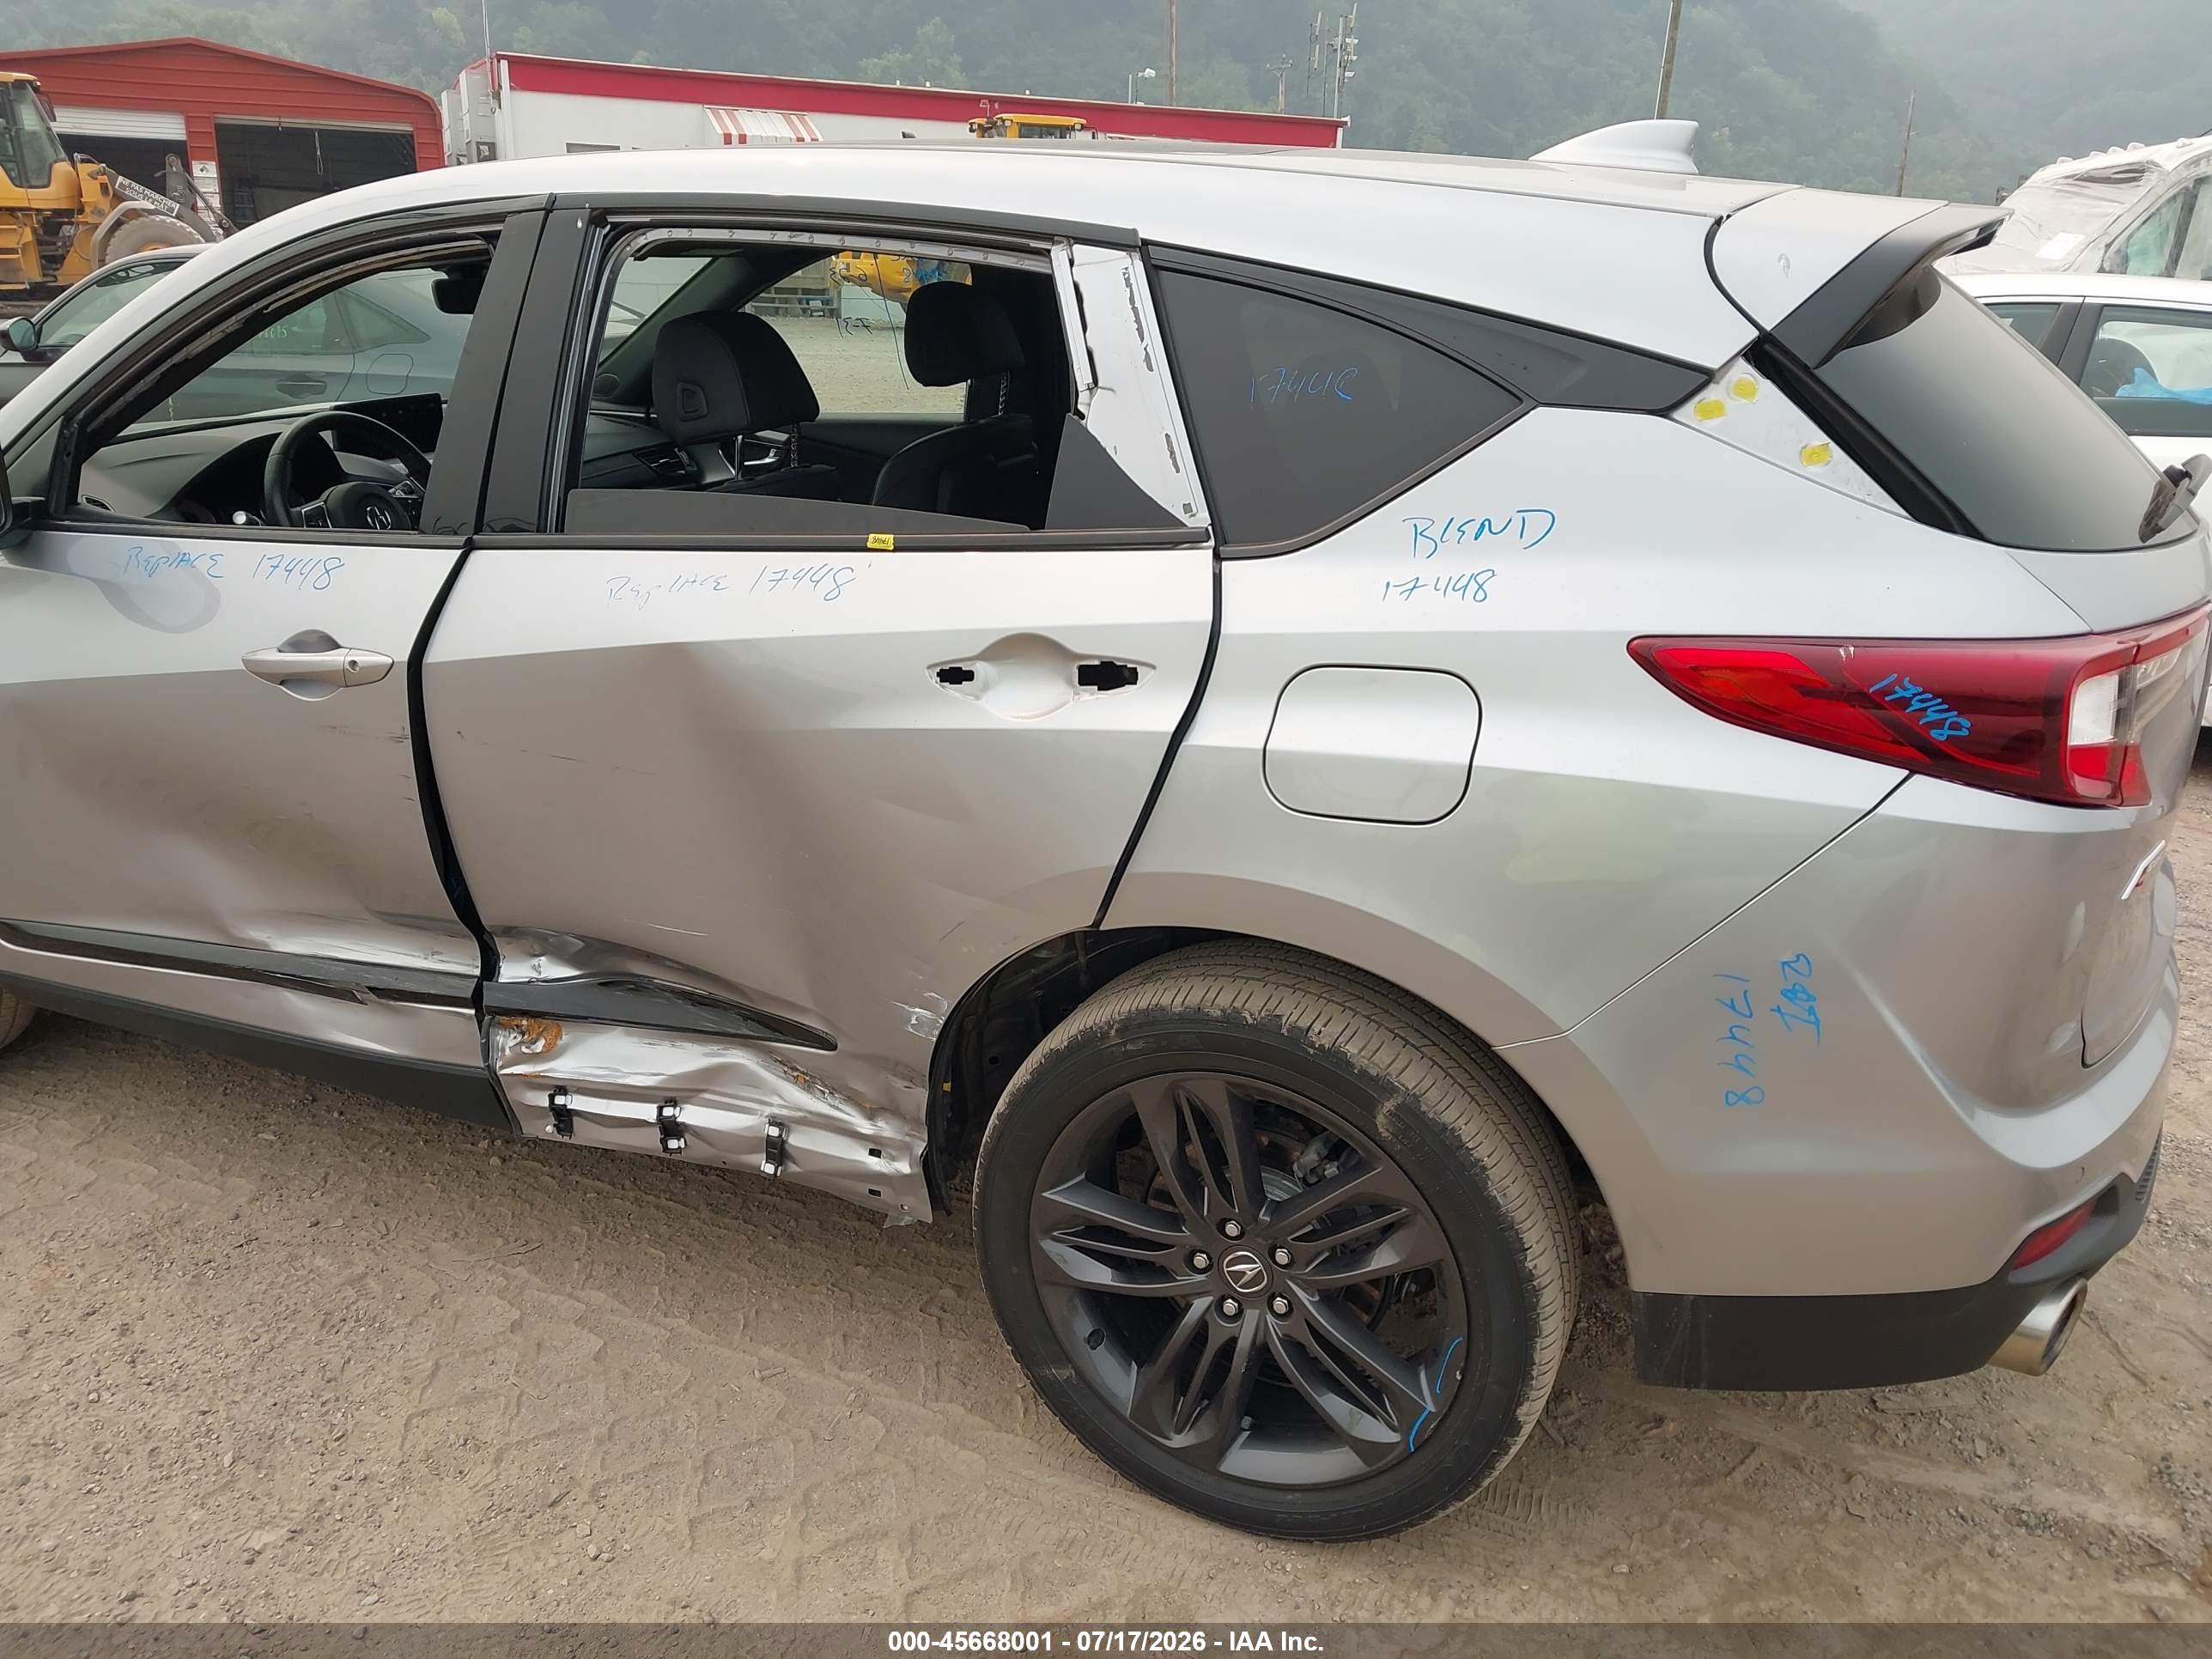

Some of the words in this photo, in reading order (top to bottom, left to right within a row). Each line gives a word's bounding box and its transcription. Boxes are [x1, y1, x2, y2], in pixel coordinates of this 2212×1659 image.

[120, 177, 130, 186] NE
[131, 182, 143, 193] PAS
[143, 189, 177, 209] MARCHER
[252, 554, 345, 591] 17448
[749, 563, 857, 601] 17448
[1382, 568, 1498, 603] 17448
[1869, 673, 1972, 741] 17448
[1712, 973, 1765, 1107] 17448
